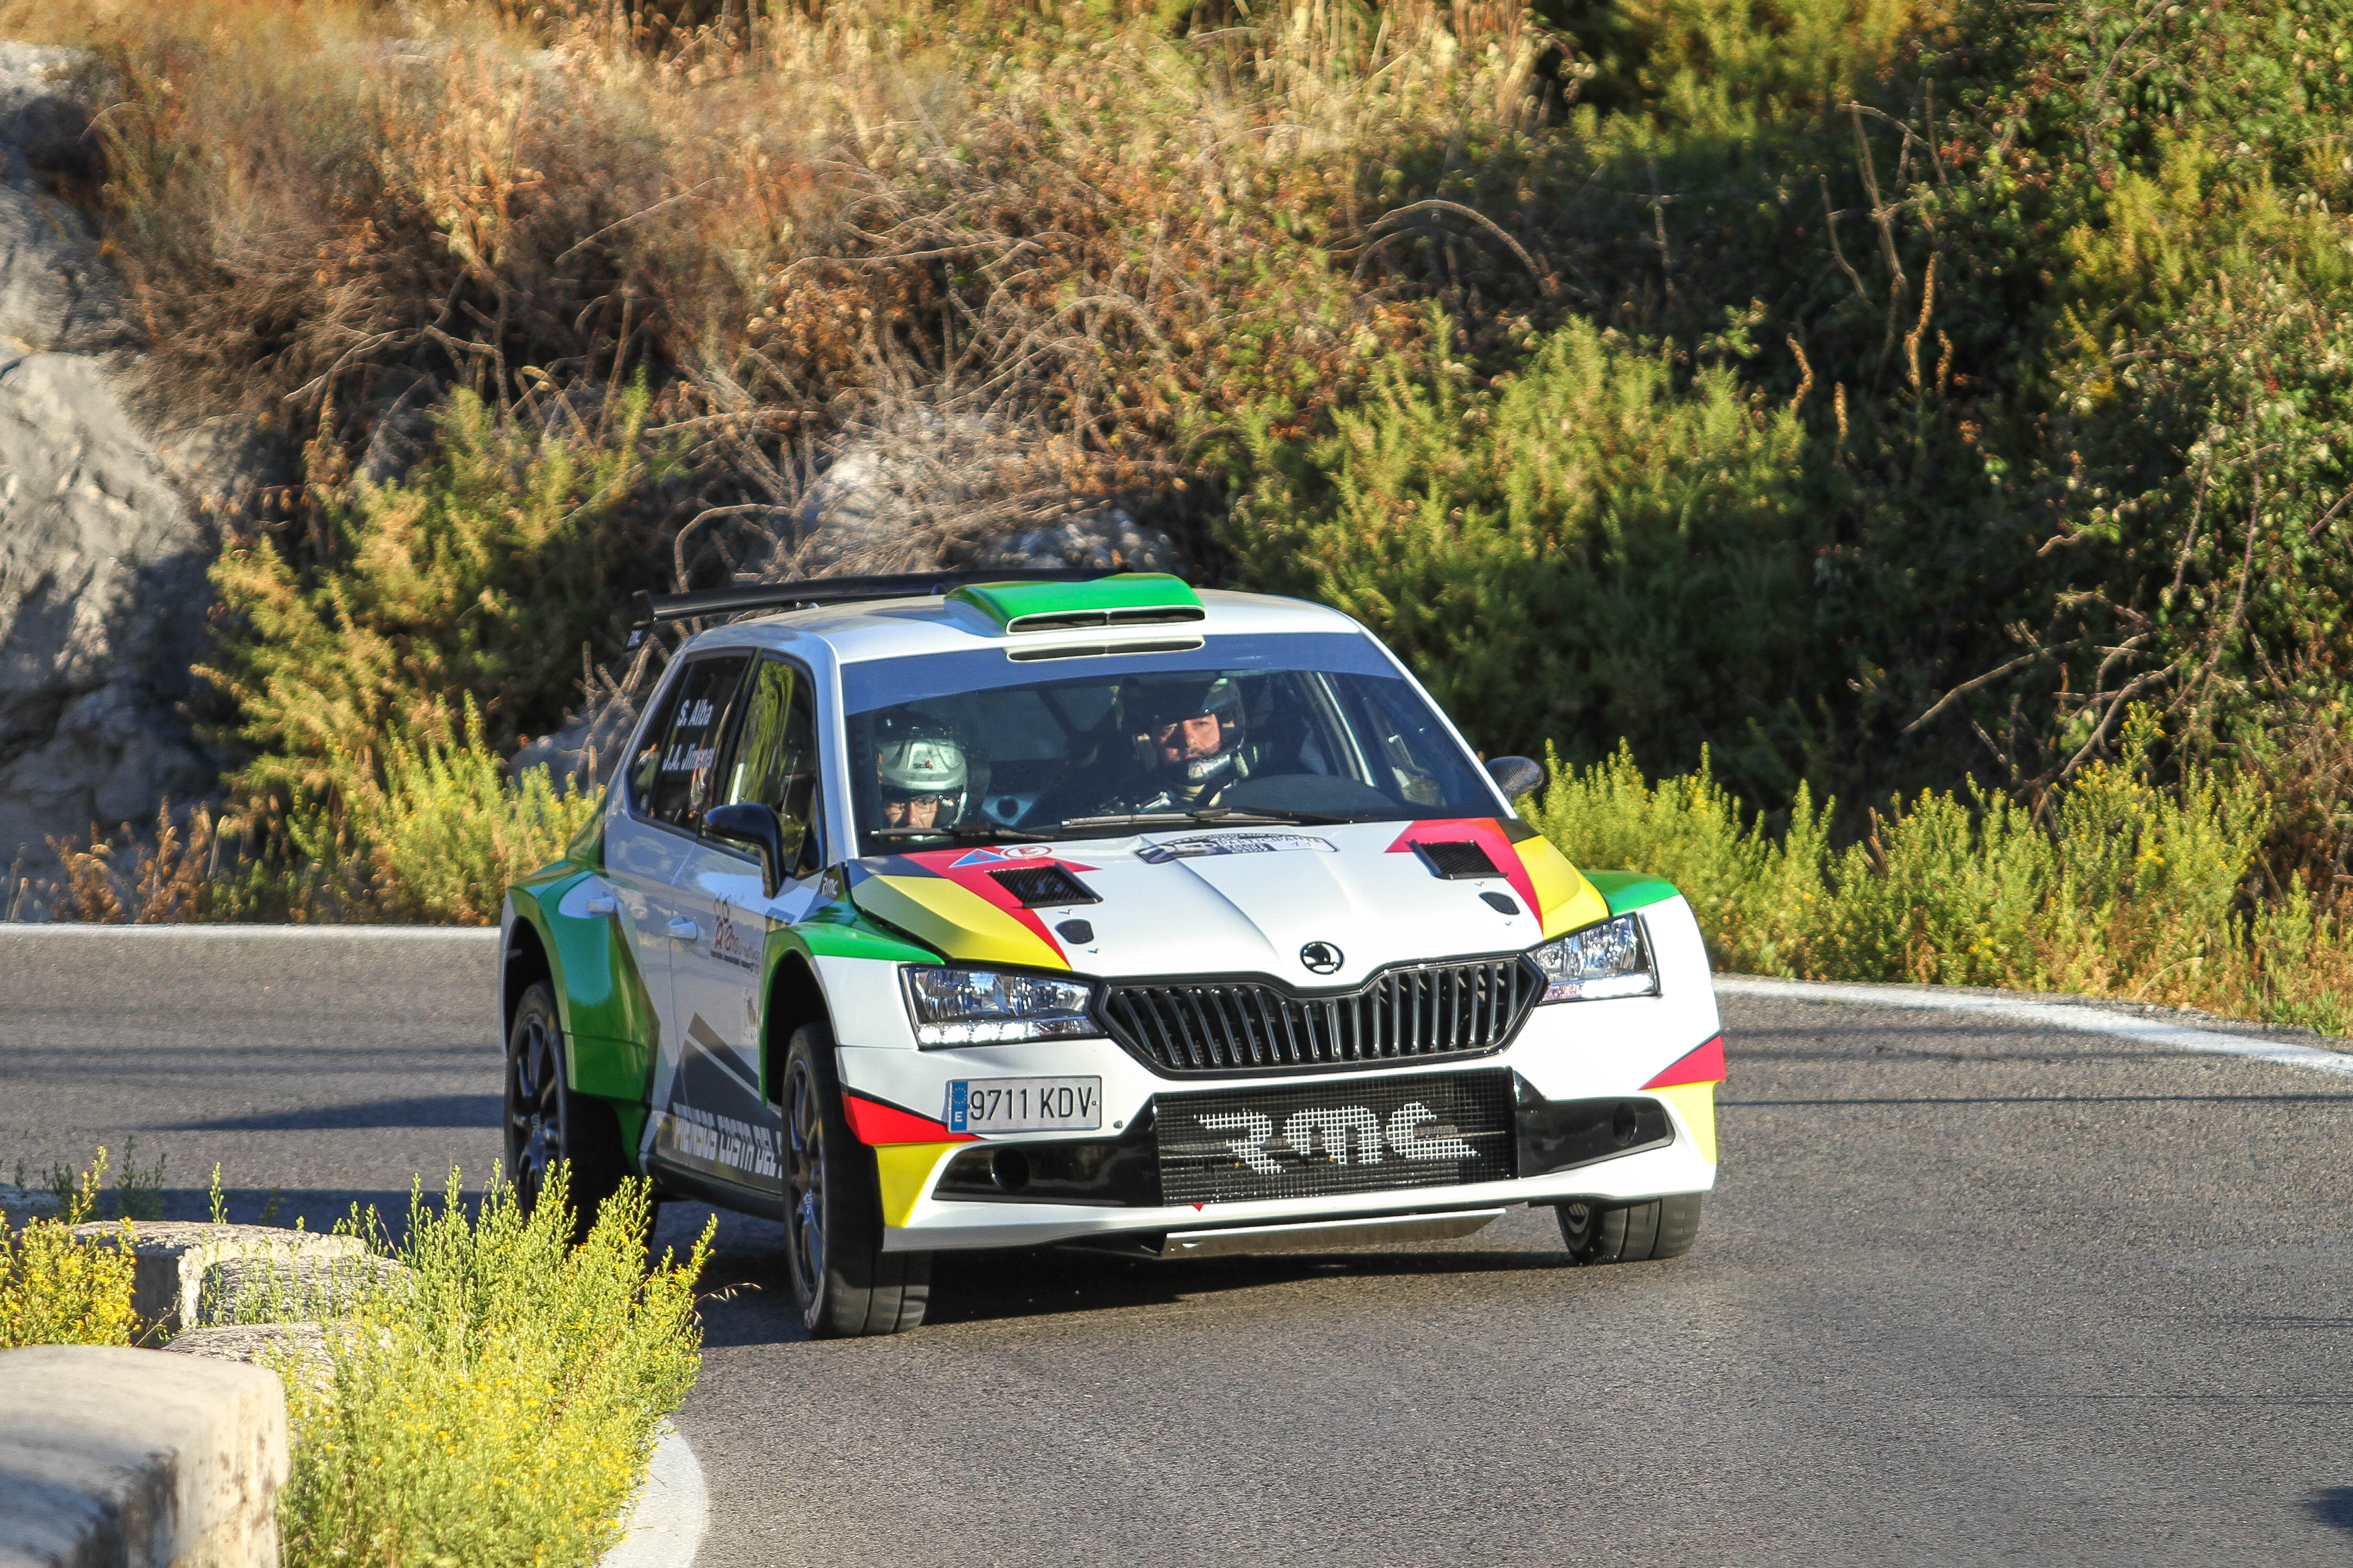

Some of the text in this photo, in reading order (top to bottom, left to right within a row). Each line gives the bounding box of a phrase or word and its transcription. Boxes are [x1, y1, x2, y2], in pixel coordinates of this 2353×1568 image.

[677, 699, 713, 726] S. Alba
[954, 1111, 963, 1122] E
[970, 1087, 1092, 1120] 9711 KDV
